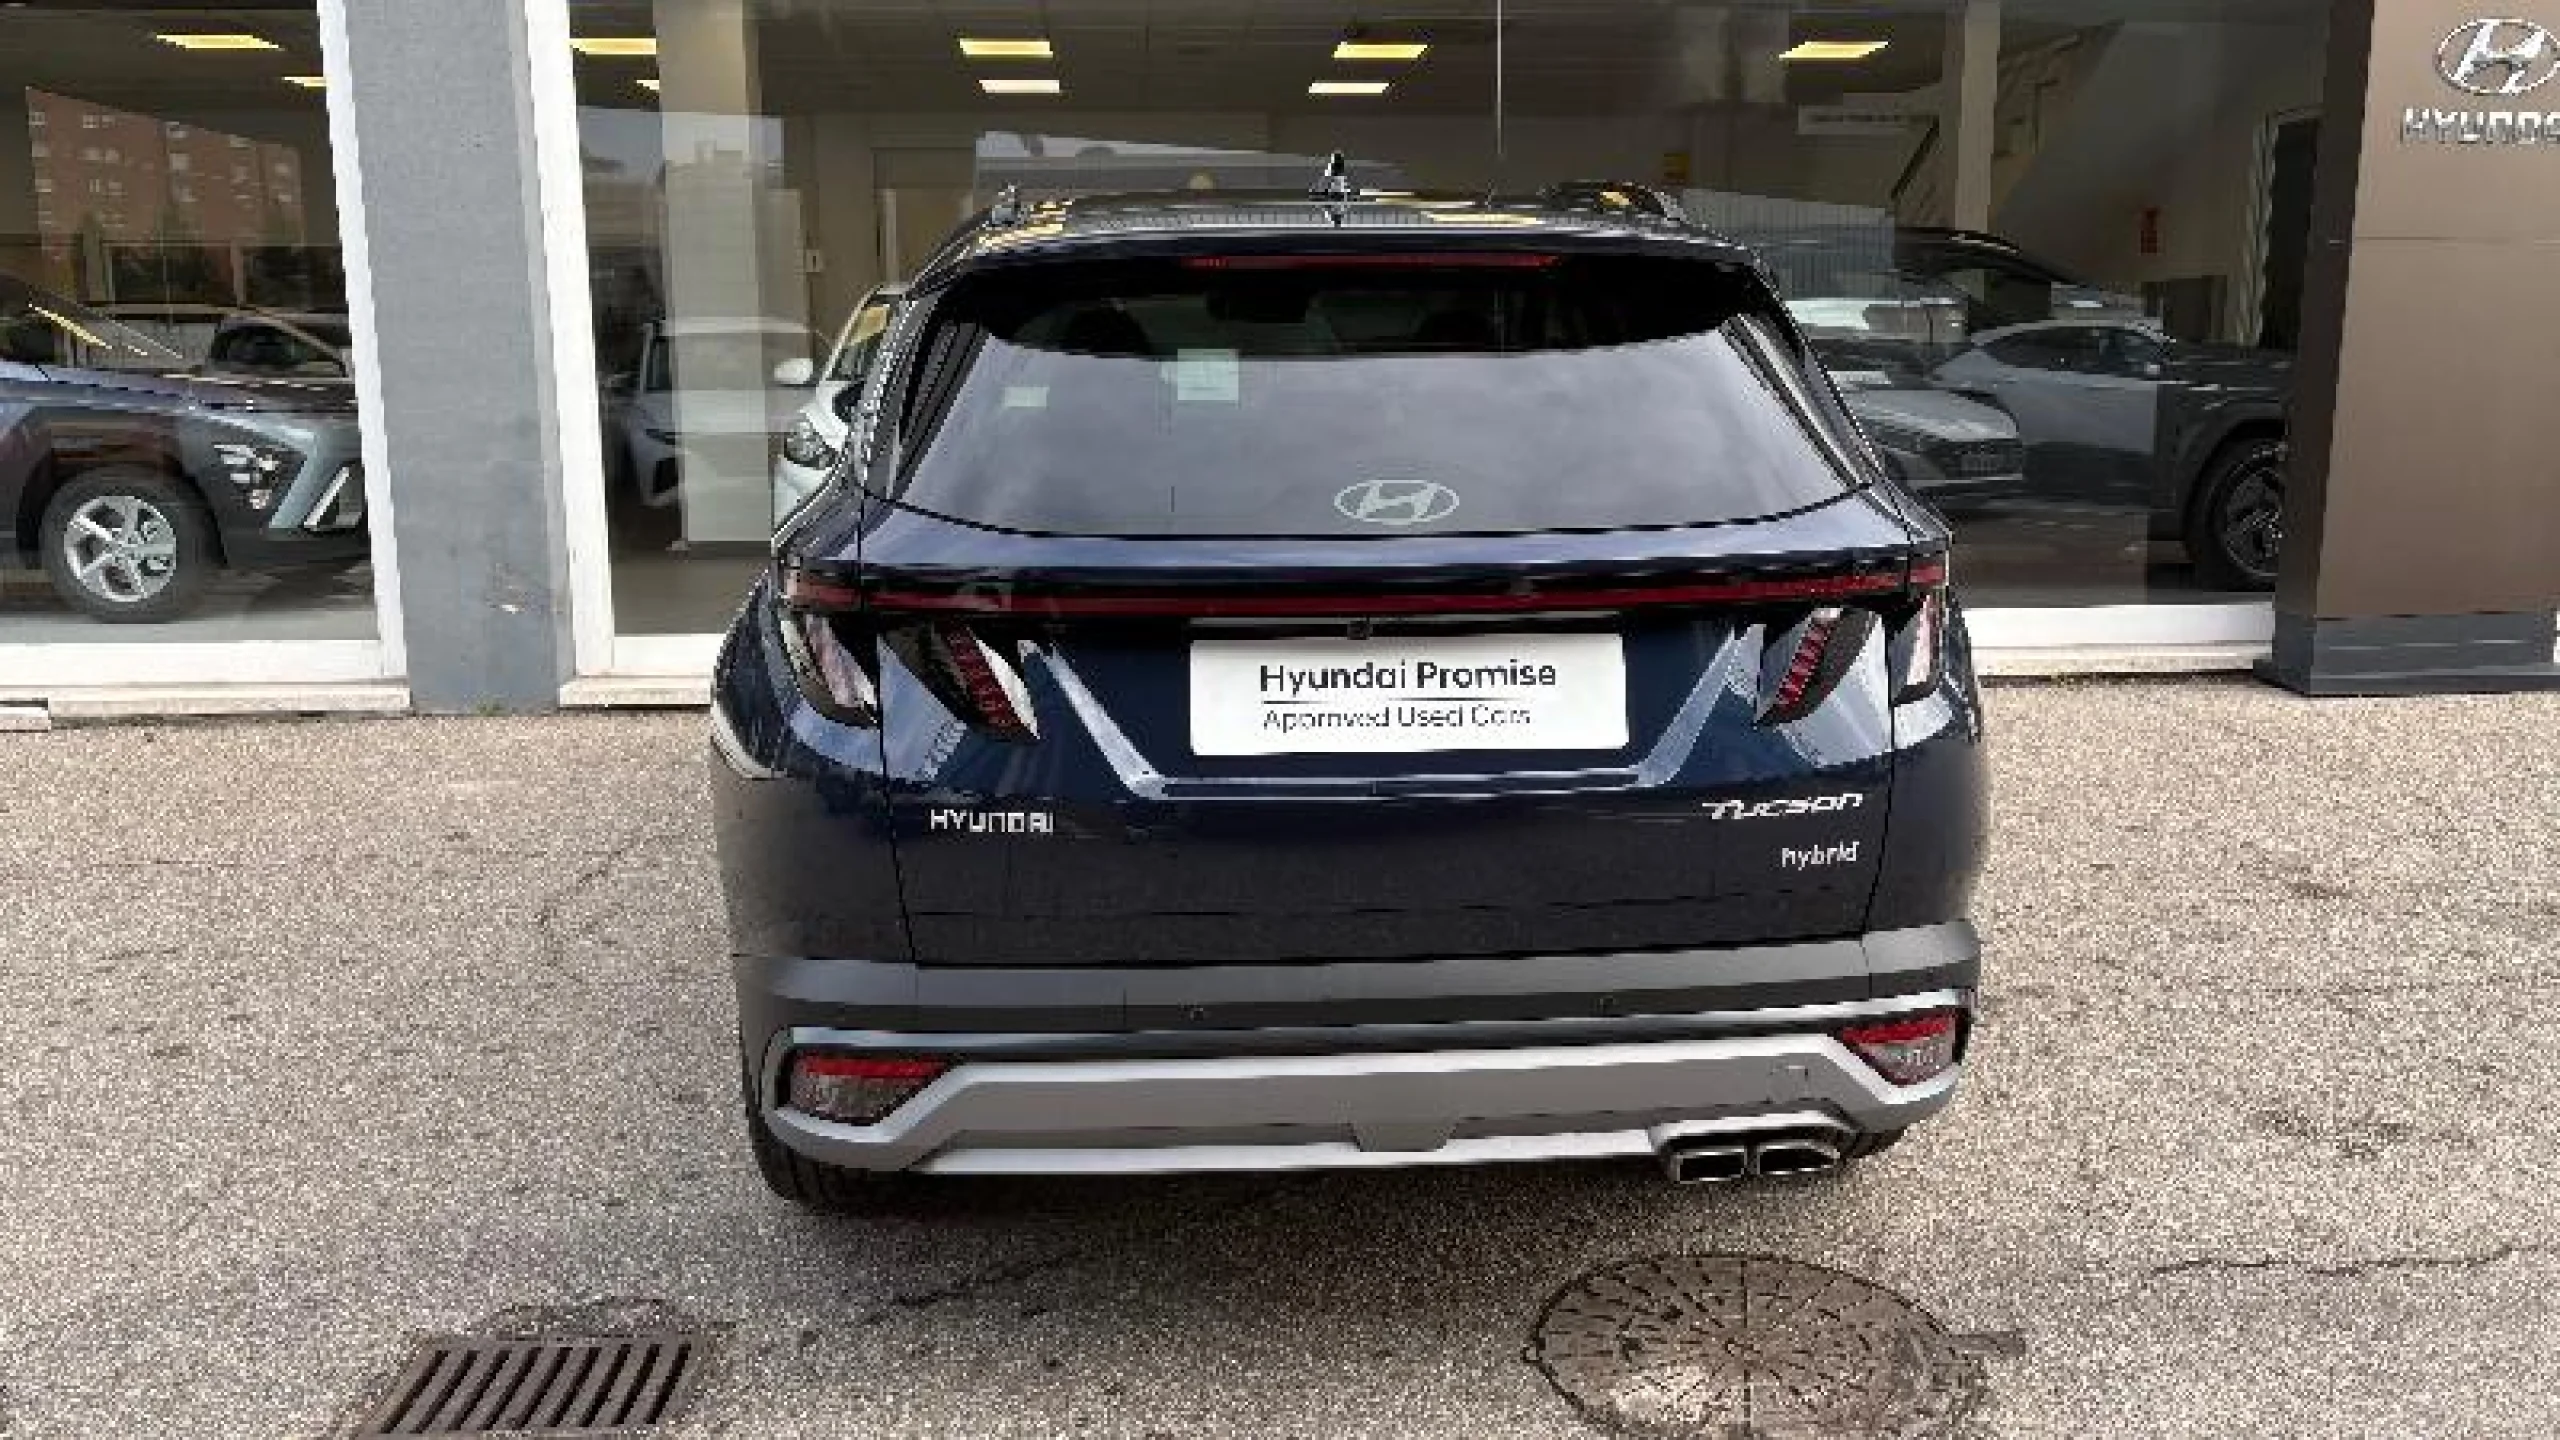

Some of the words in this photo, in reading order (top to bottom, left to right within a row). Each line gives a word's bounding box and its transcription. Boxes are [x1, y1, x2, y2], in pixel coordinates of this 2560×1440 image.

[1260, 659, 1405, 697] Hyundai
[1417, 658, 1556, 688] Promise
[1397, 704, 1463, 727] Used
[1471, 703, 1531, 728] Cars
[930, 809, 1054, 833] HYUNDAI
[1781, 840, 1860, 871] hybrid
